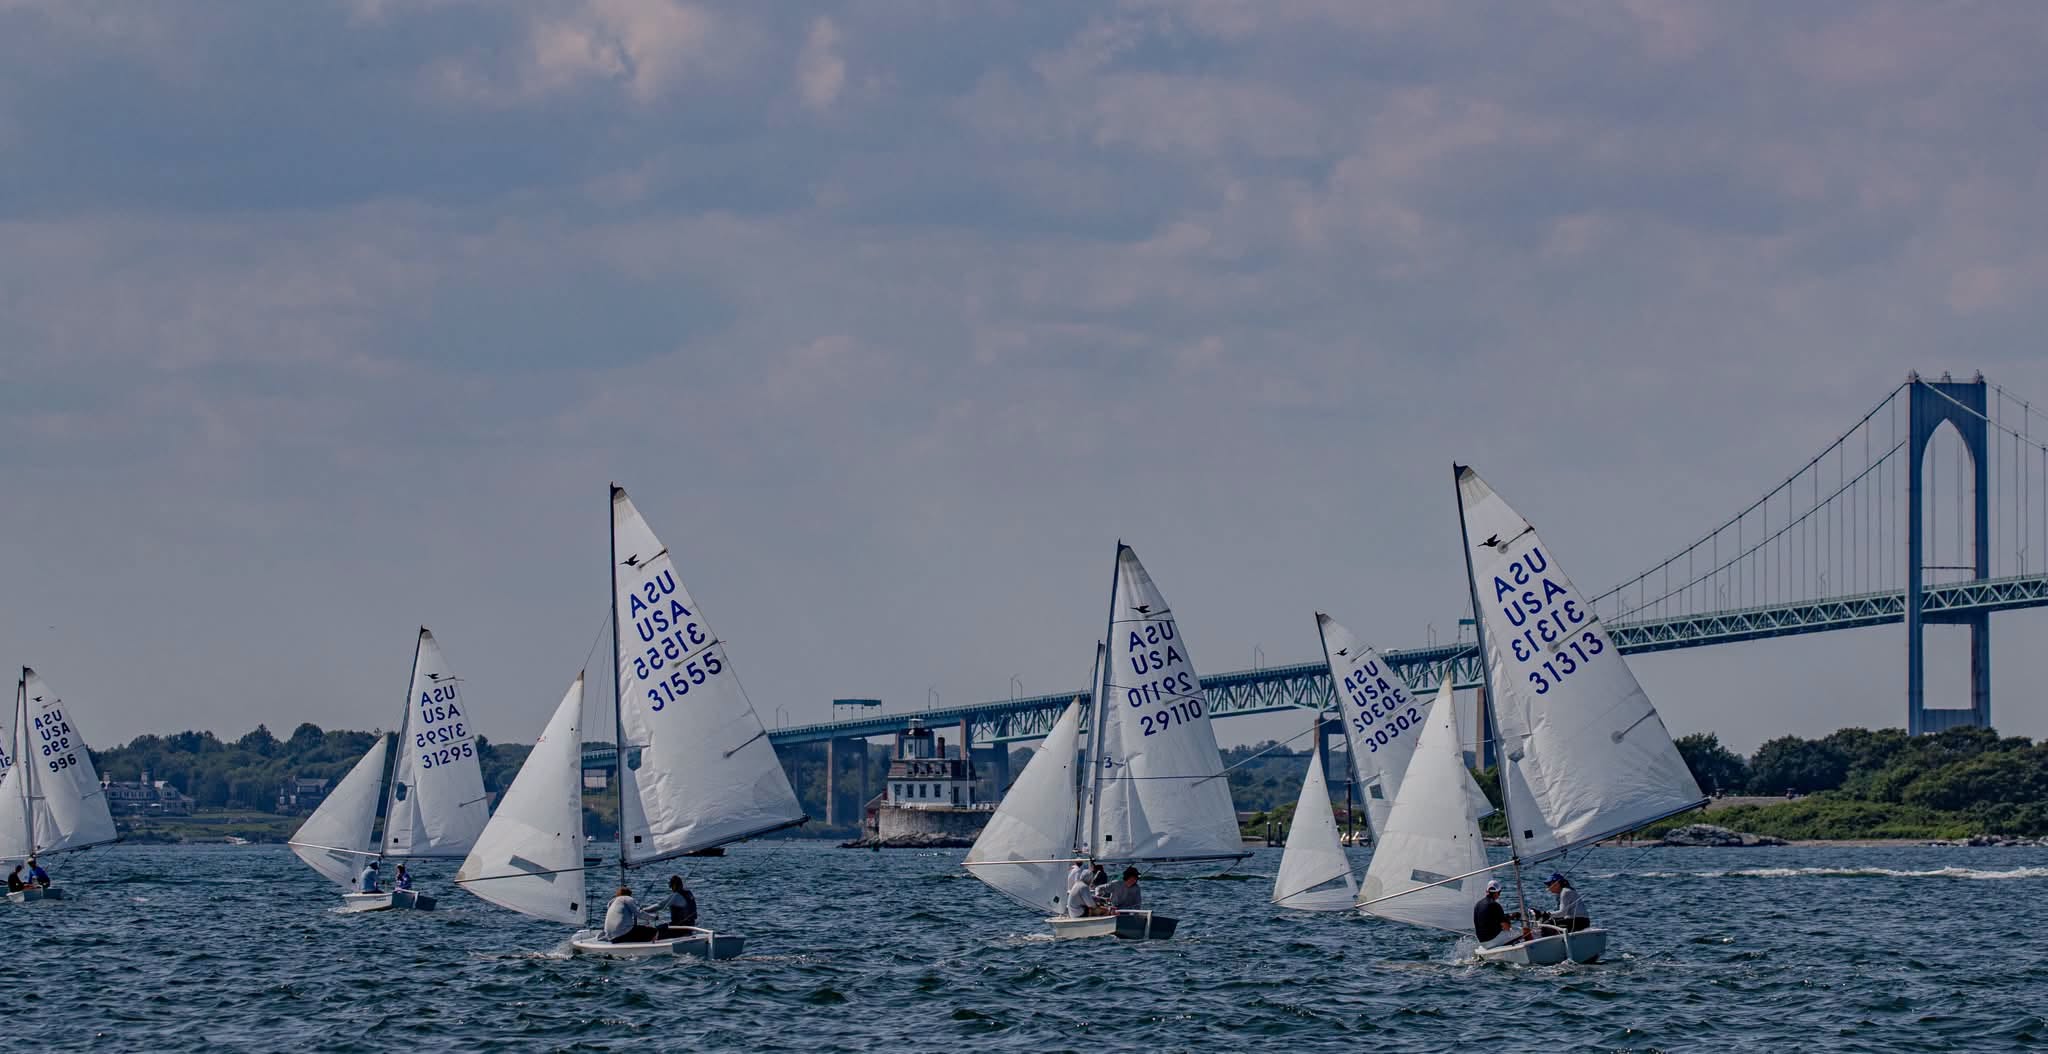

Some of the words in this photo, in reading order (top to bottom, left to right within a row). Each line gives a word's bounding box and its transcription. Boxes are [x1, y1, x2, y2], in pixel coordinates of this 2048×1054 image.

[1504, 578, 1567, 627] USA
[636, 599, 692, 642] USA
[1131, 645, 1183, 675] USA
[1529, 632, 1604, 695] 31313
[648, 651, 722, 712] 31555
[1352, 677, 1391, 707] USA
[423, 703, 460, 724] USA
[1140, 700, 1202, 736] 29110
[1365, 708, 1422, 752] 30302
[41, 722, 71, 741] USA
[49, 753, 77, 772] 996
[422, 743, 472, 769] 31295
